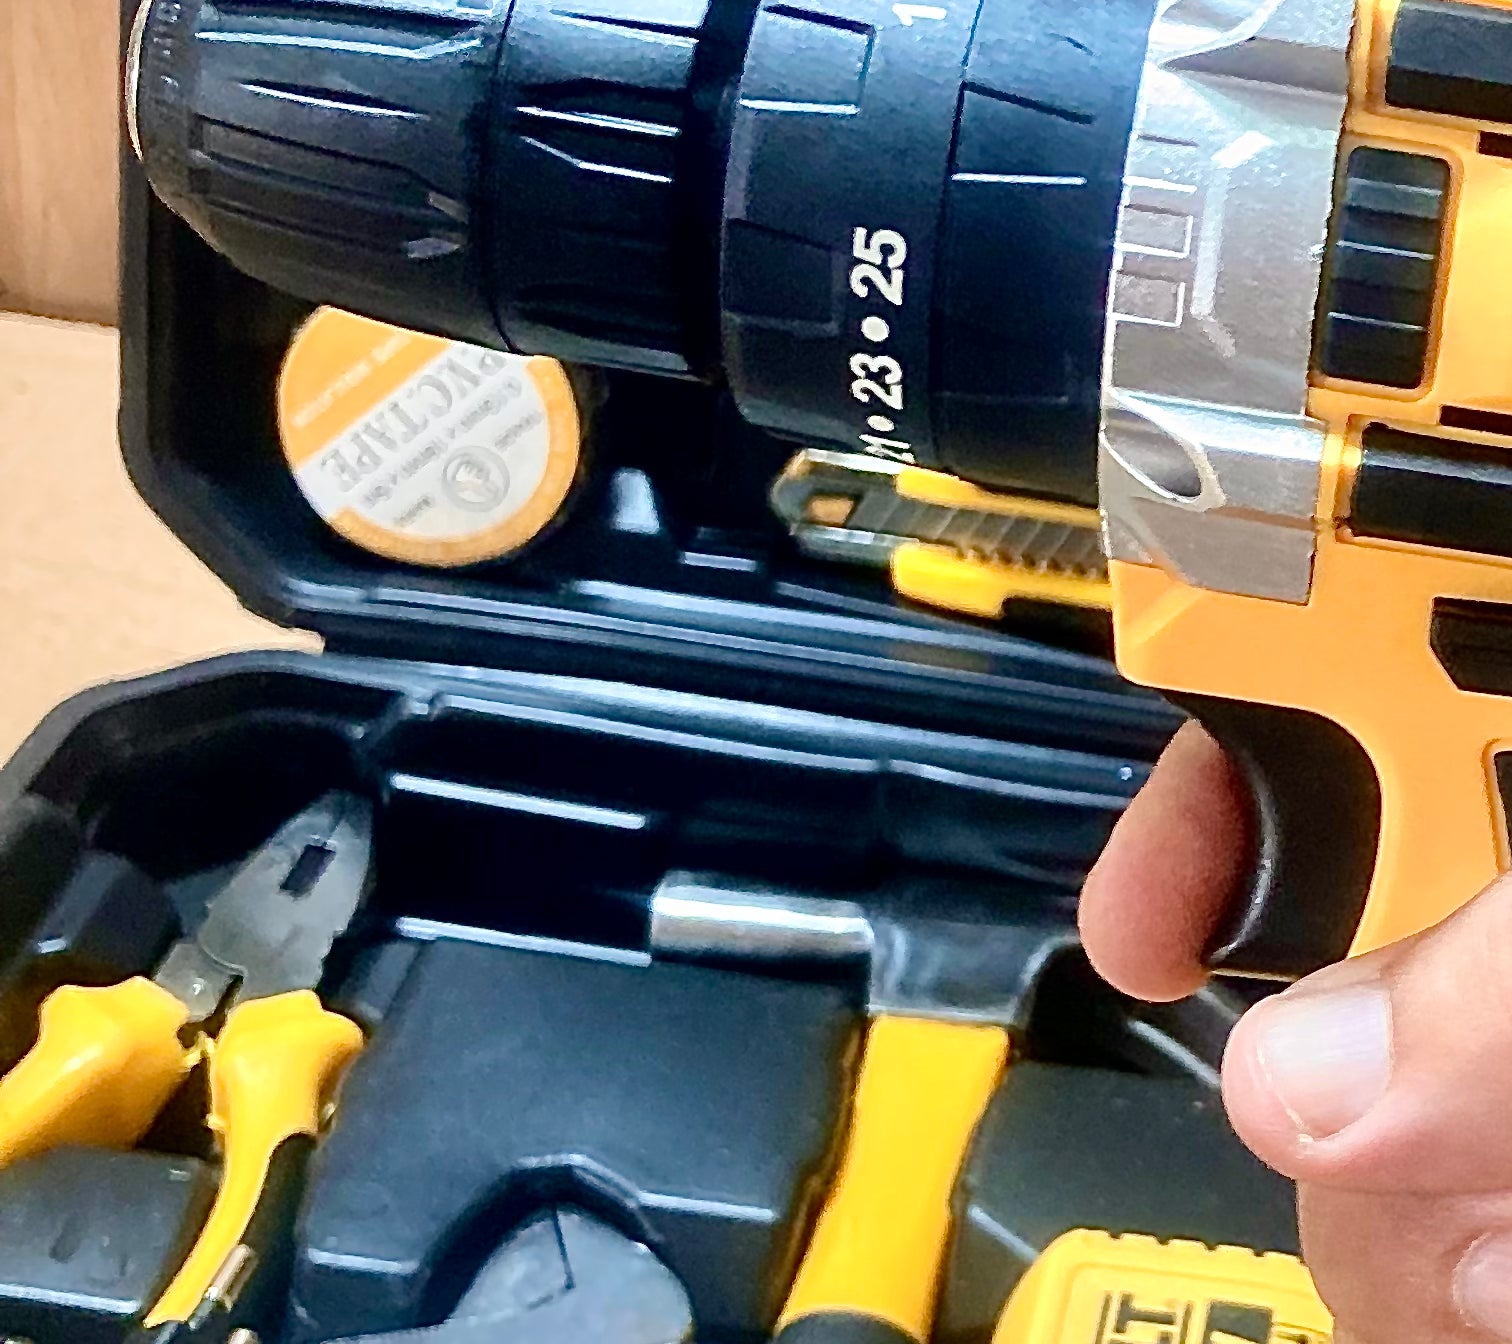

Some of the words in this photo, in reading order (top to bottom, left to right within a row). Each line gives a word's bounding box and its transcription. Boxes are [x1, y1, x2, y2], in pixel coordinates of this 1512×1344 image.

[892, 1, 947, 25] 1
[849, 227, 908, 306] 25
[849, 354, 904, 410] 23
